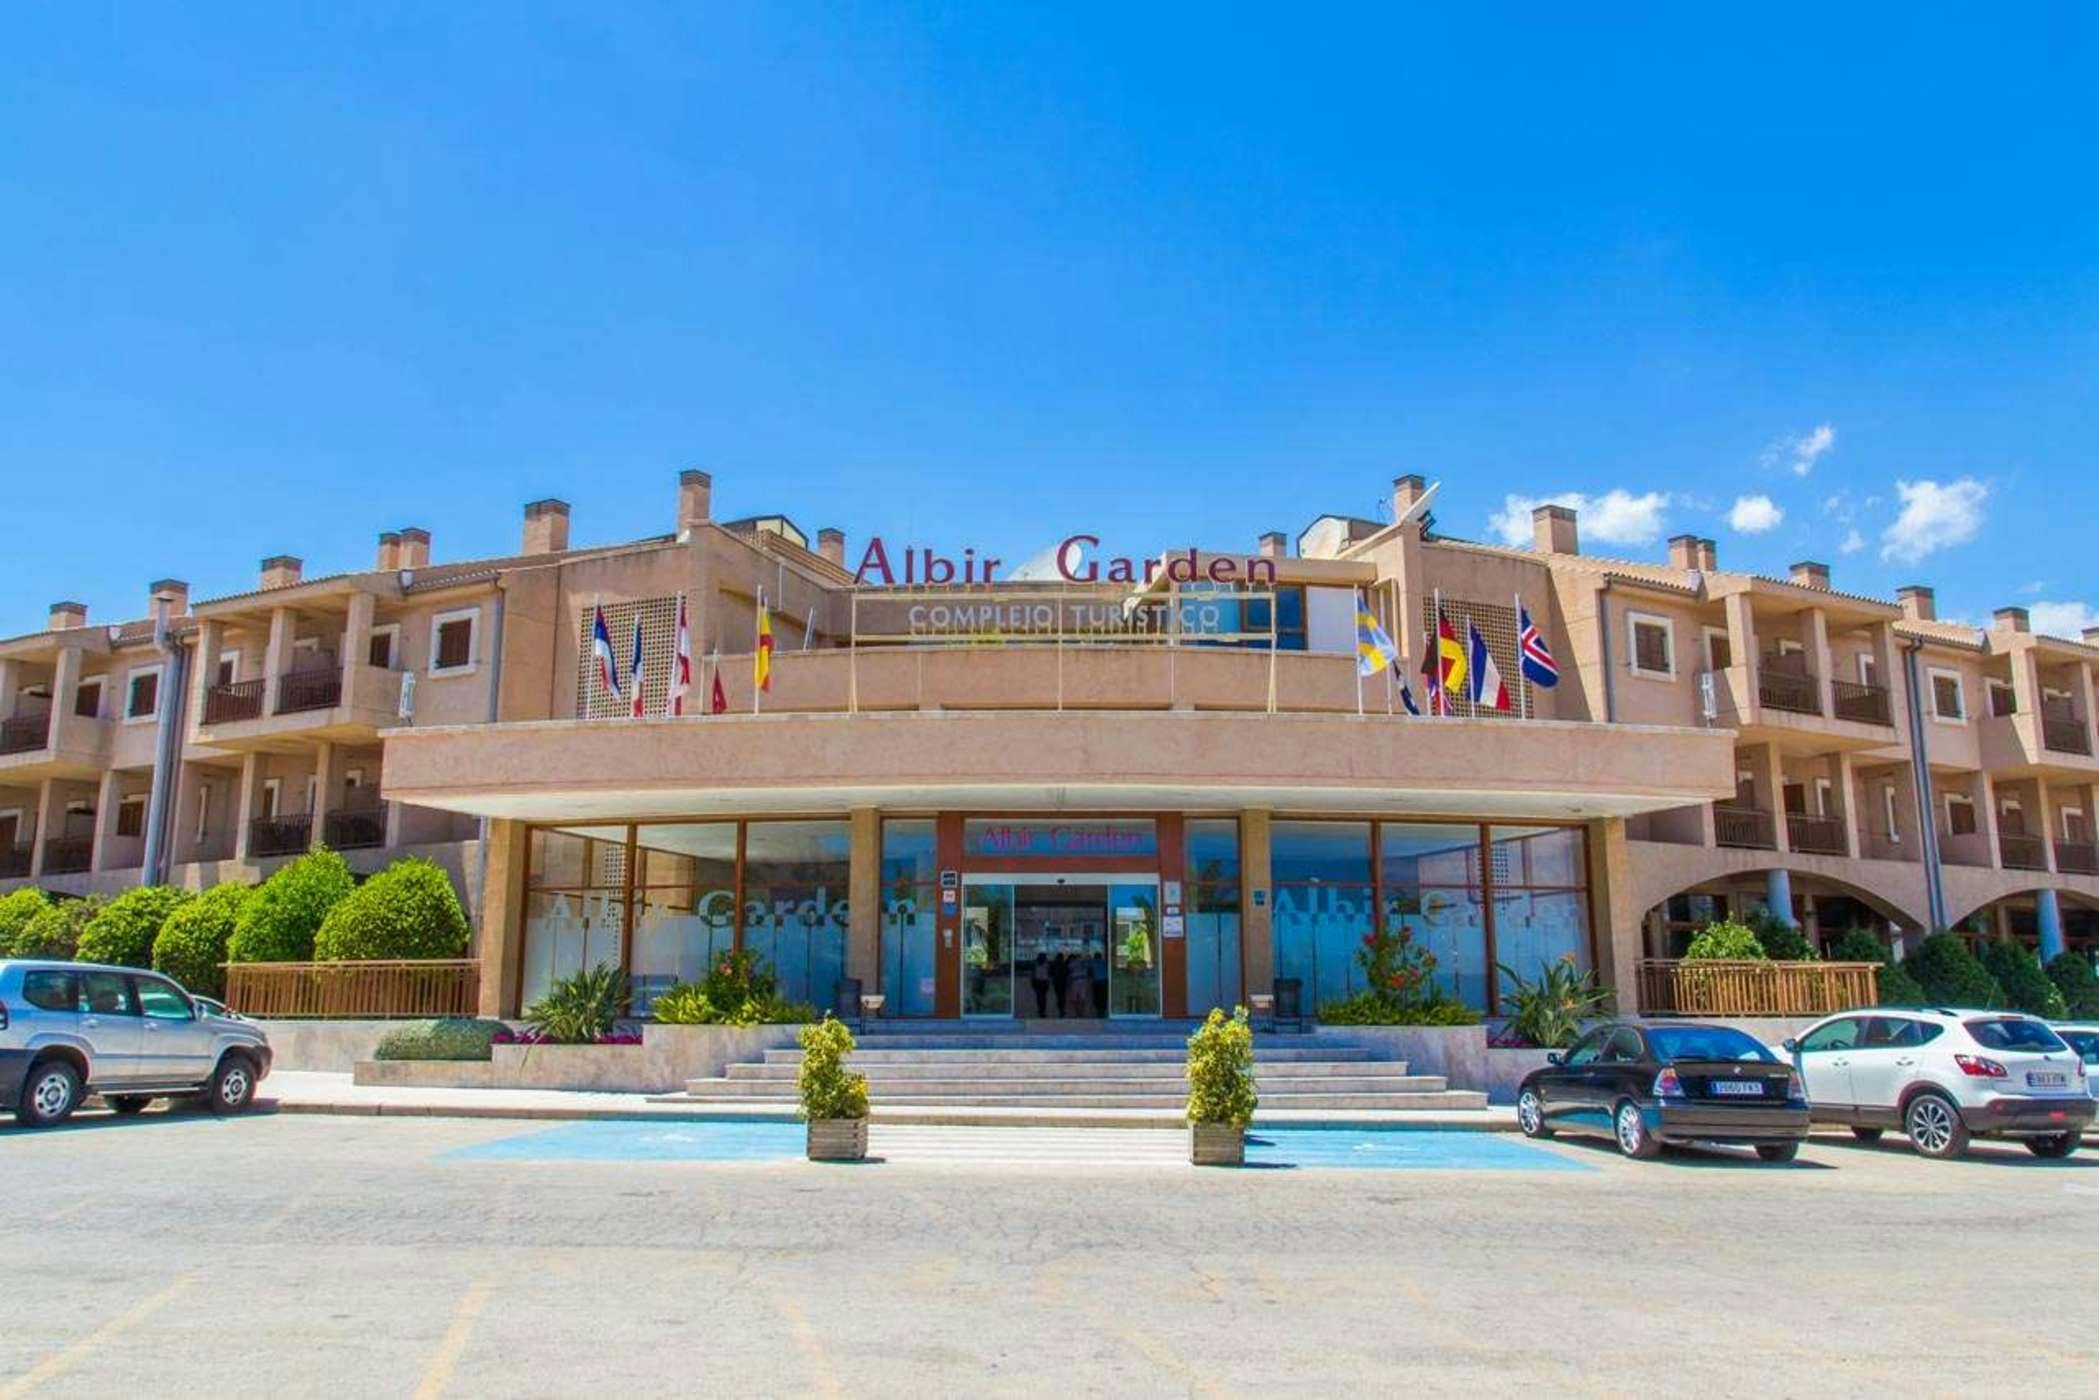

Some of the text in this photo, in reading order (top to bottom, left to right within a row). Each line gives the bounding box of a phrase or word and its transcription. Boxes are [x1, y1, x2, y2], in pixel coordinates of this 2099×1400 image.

[854, 534, 1277, 585] Albir Garden
[908, 604, 1054, 628] COMPLEJO
